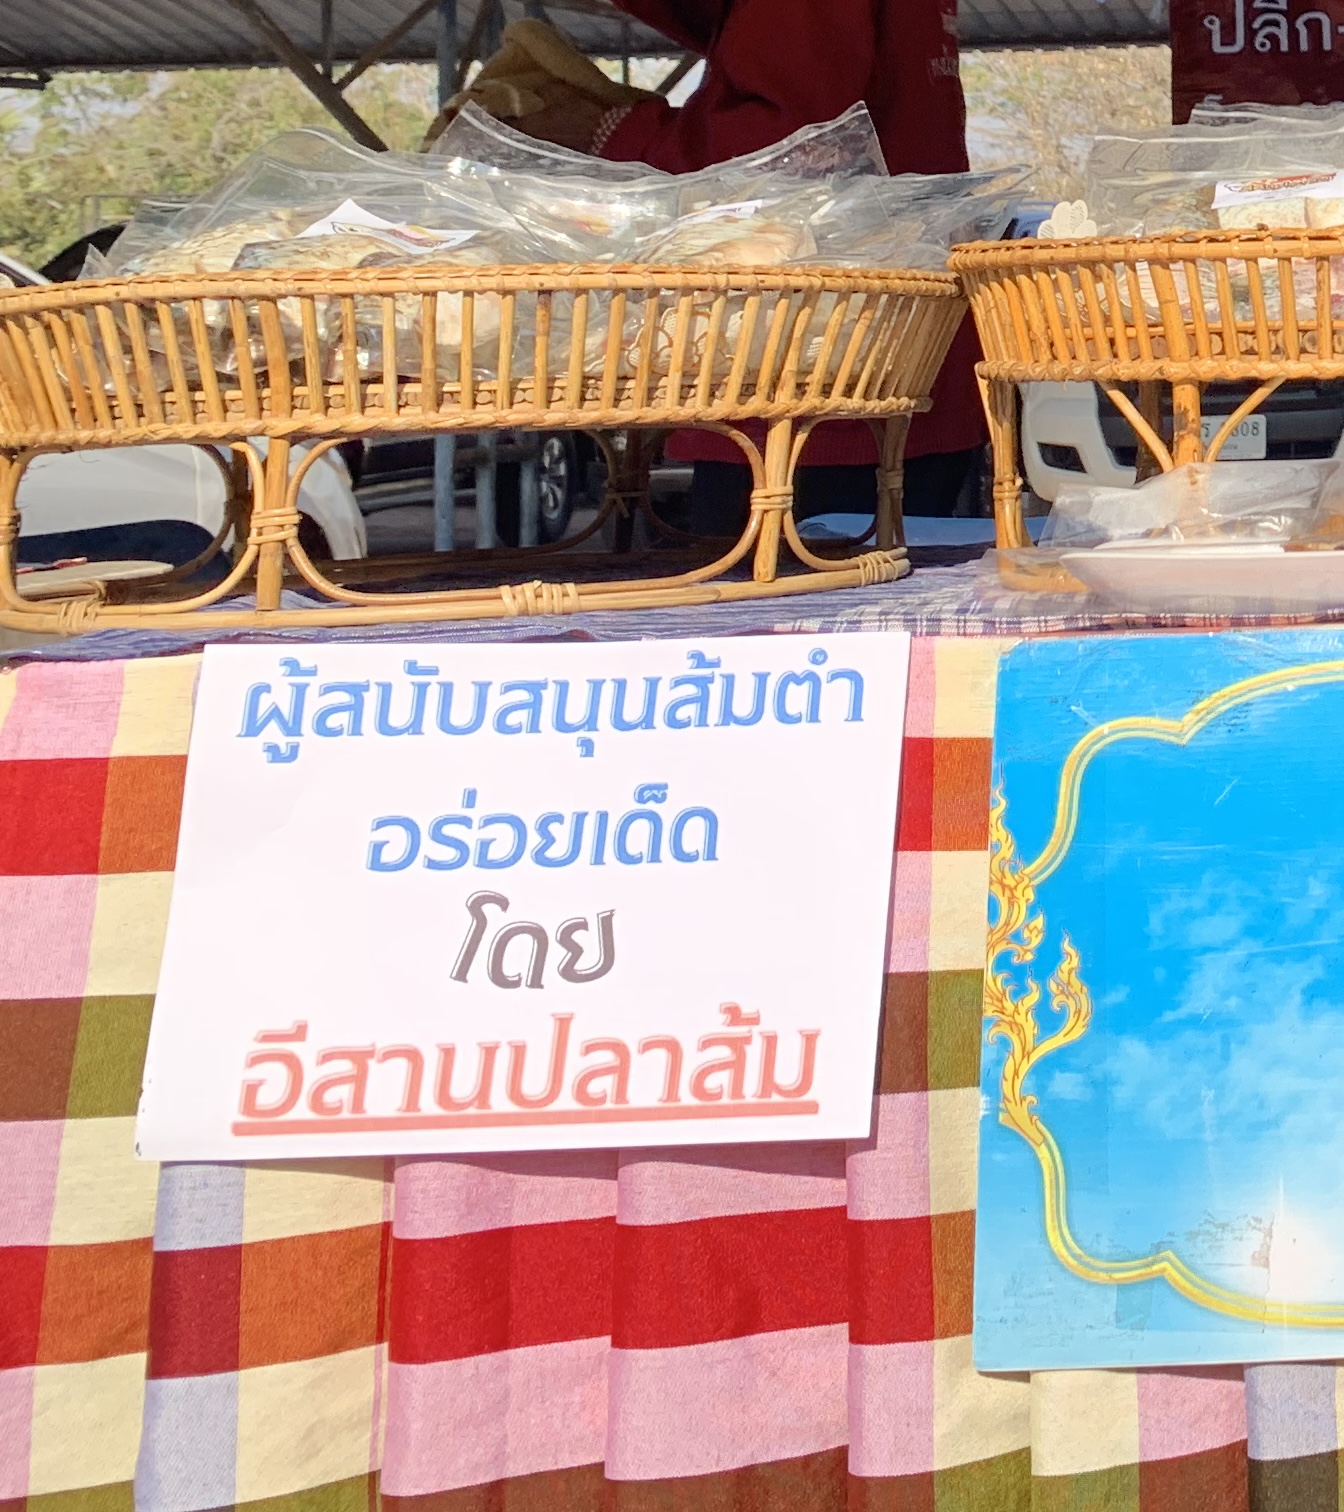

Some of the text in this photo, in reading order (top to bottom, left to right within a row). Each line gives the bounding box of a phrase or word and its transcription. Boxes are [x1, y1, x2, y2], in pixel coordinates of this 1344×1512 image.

[237, 648, 866, 764] ผู้สนับสนุนส้มตำ
[366, 782, 720, 873] อร่อยเด็ด
[449, 890, 617, 990] โดย
[236, 1002, 822, 1120] อีสานปลาส้ม
